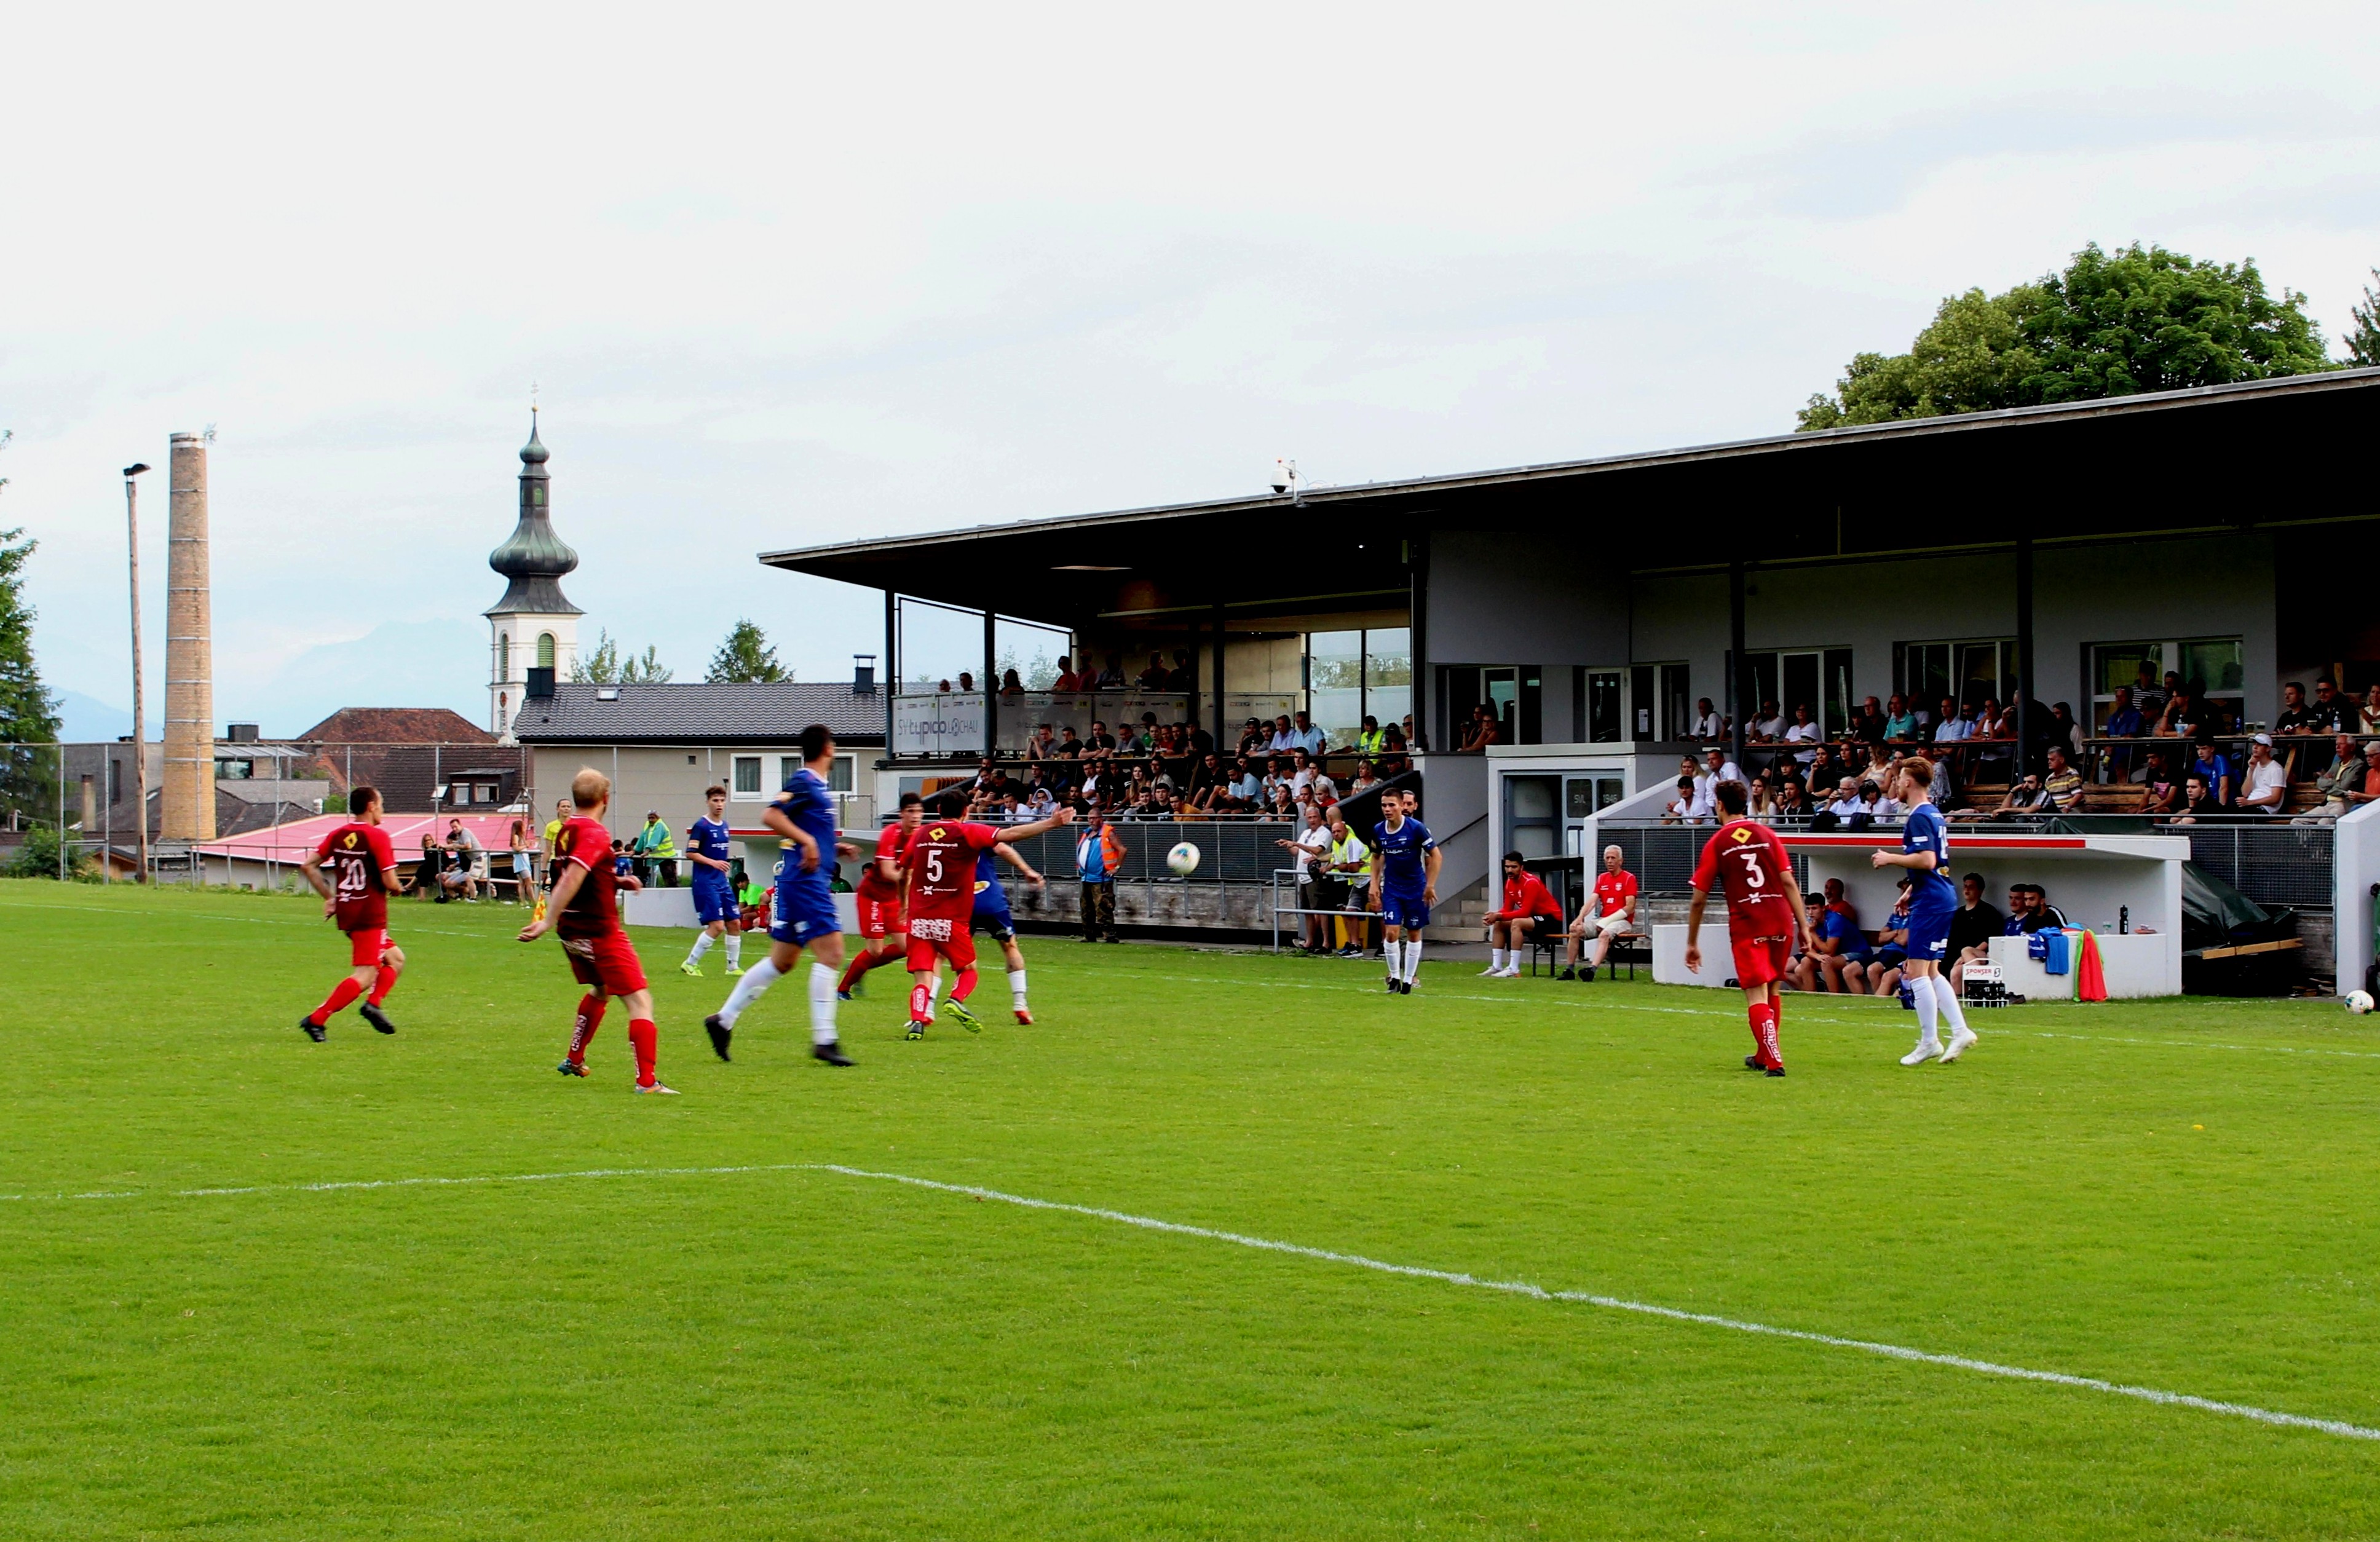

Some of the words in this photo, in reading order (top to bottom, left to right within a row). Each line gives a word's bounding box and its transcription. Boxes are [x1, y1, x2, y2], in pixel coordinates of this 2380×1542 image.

[338, 858, 367, 891] 20
[927, 850, 943, 882] 5
[1739, 853, 1765, 888] 3
[1383, 911, 1394, 920] 14
